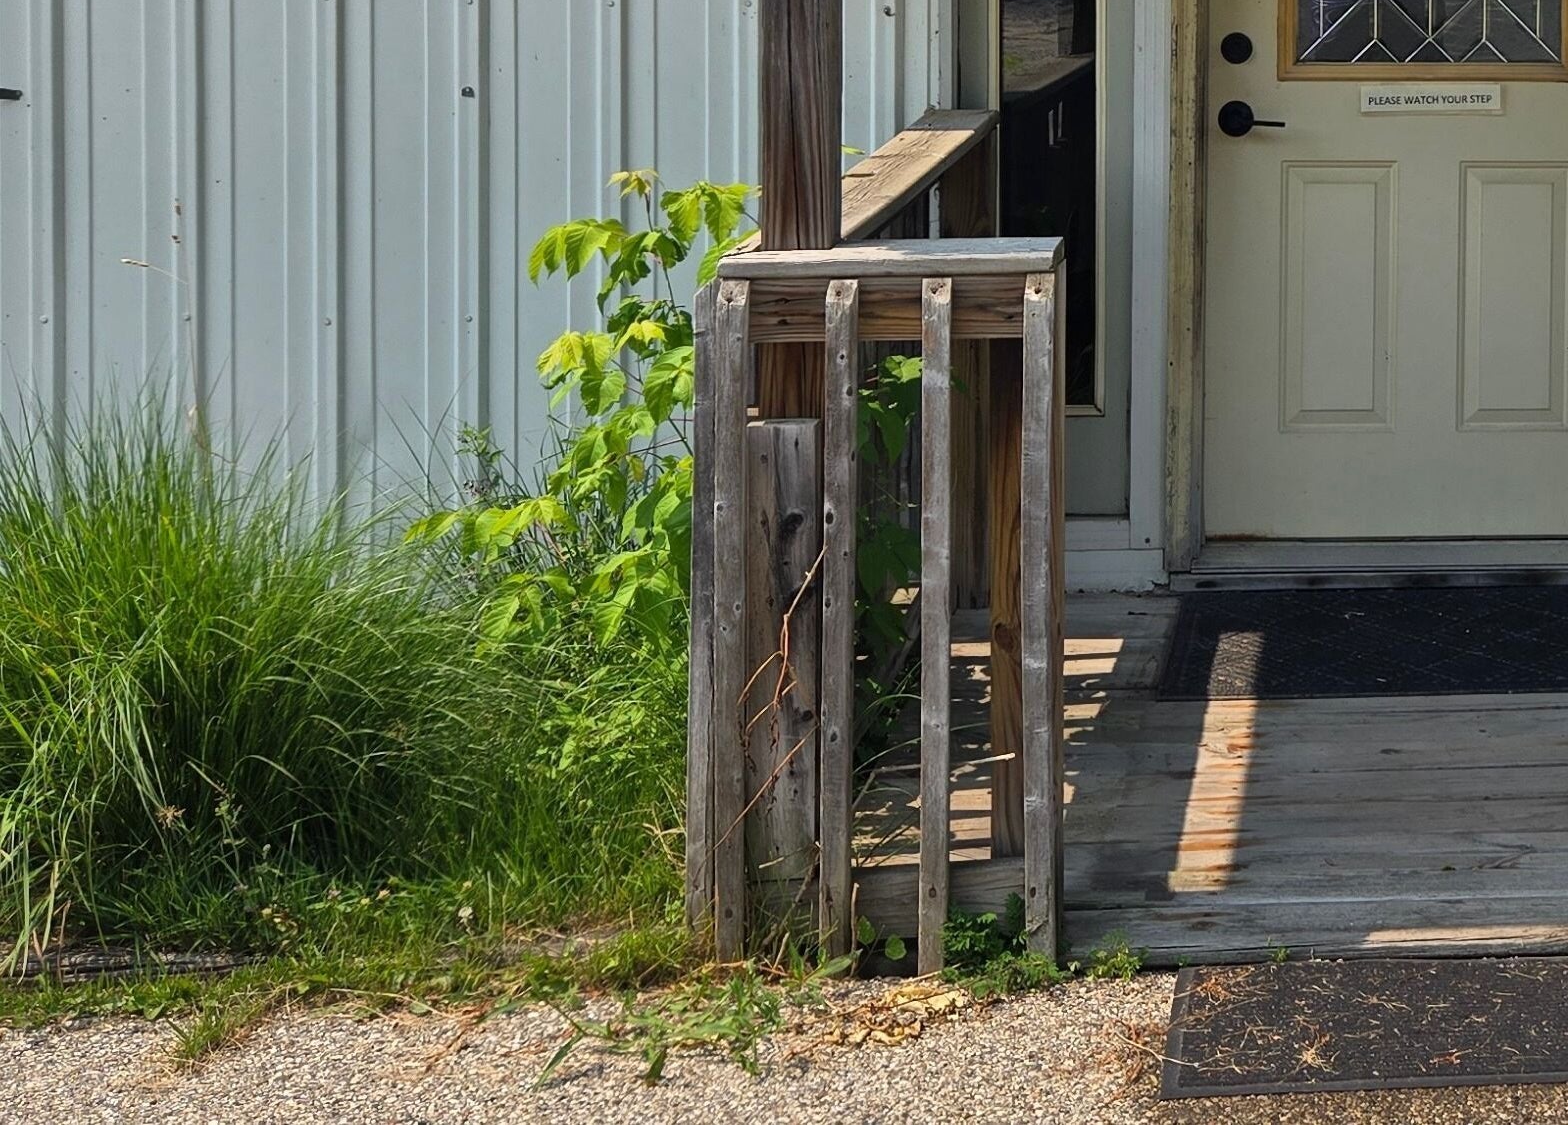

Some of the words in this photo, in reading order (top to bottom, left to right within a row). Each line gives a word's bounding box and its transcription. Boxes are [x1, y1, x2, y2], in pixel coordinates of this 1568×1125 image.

[1368, 95, 1402, 105] PLEASE
[1404, 95, 1440, 104] WATCH
[1441, 94, 1469, 104] YOUR
[1469, 94, 1493, 104] STEP
